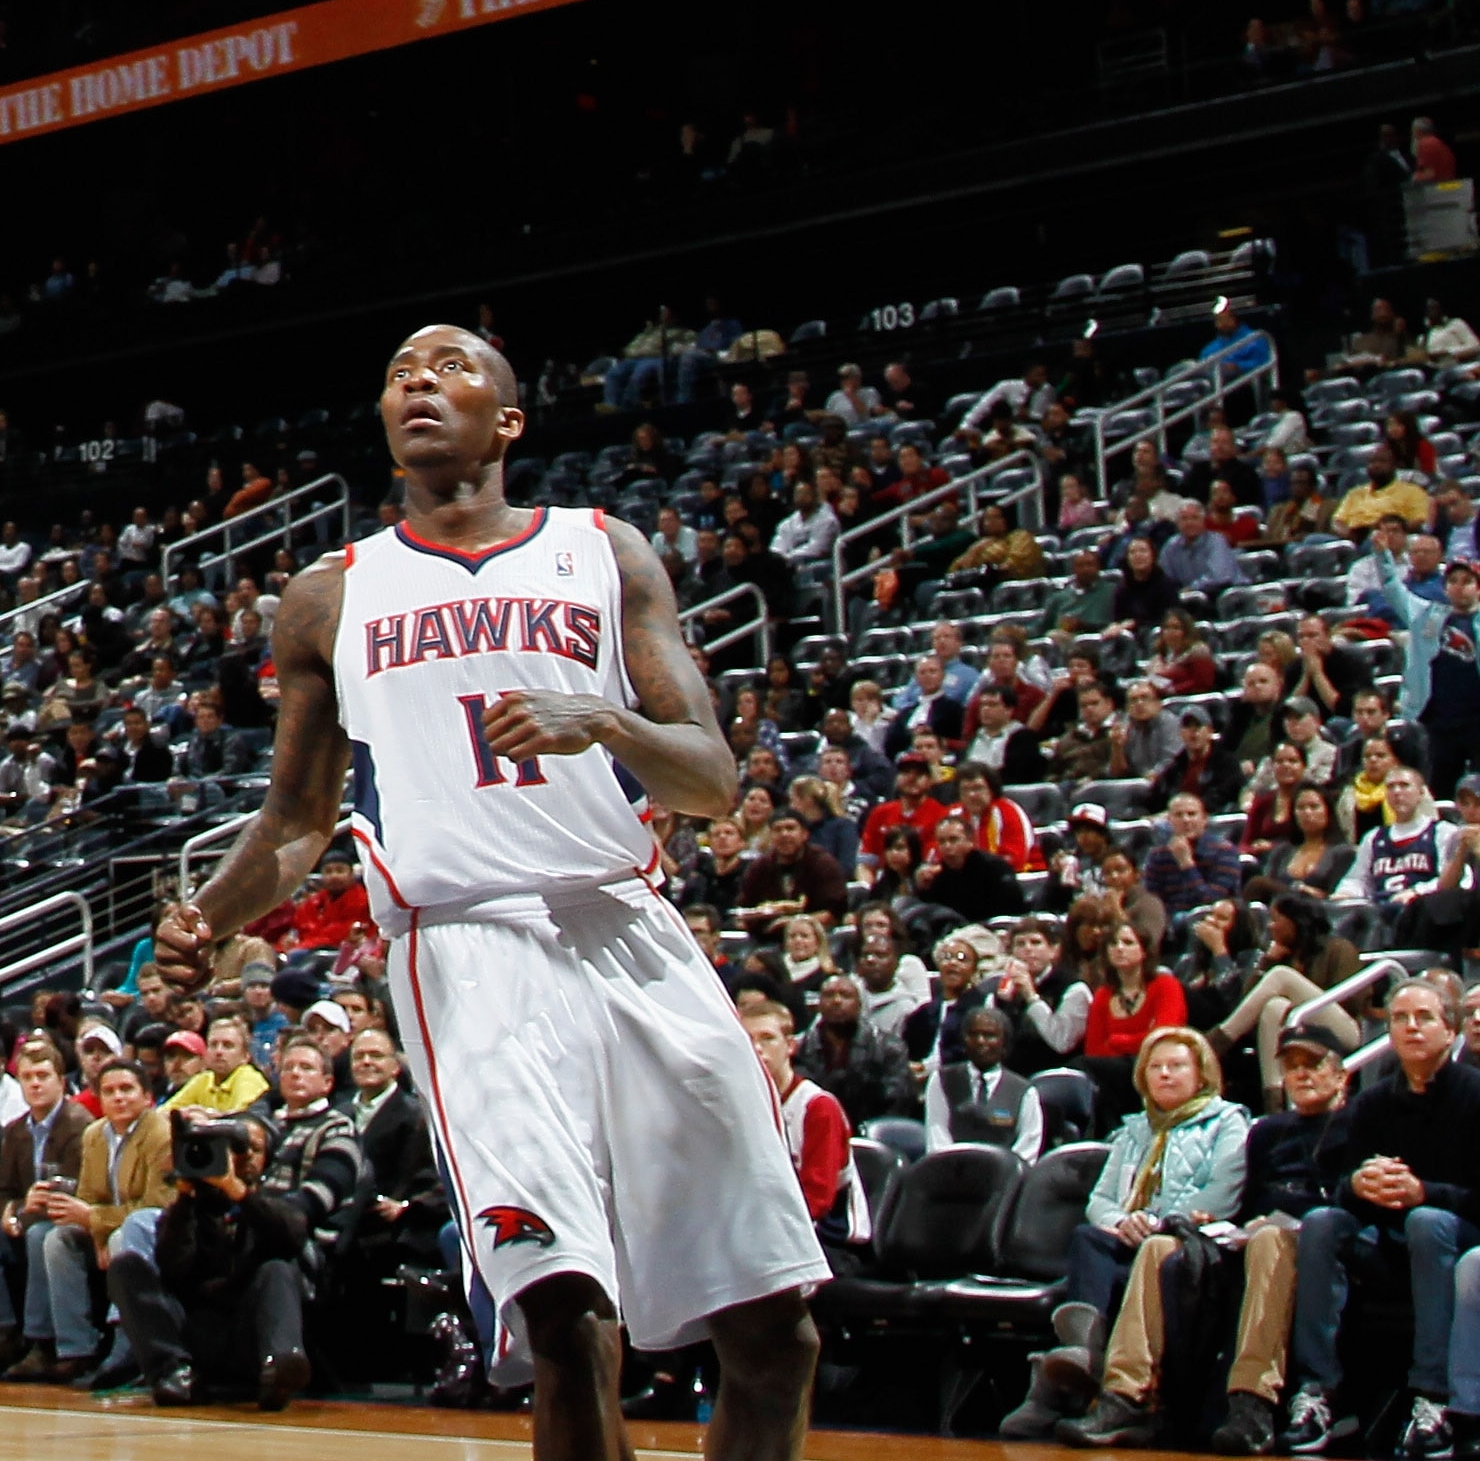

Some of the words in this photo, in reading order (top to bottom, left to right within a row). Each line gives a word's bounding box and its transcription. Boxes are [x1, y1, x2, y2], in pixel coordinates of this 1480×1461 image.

[70, 53, 172, 119] HOME
[178, 21, 300, 92] DEPOT
[870, 300, 916, 332] 103
[79, 438, 116, 462] 102
[364, 596, 602, 681] HAWKS
